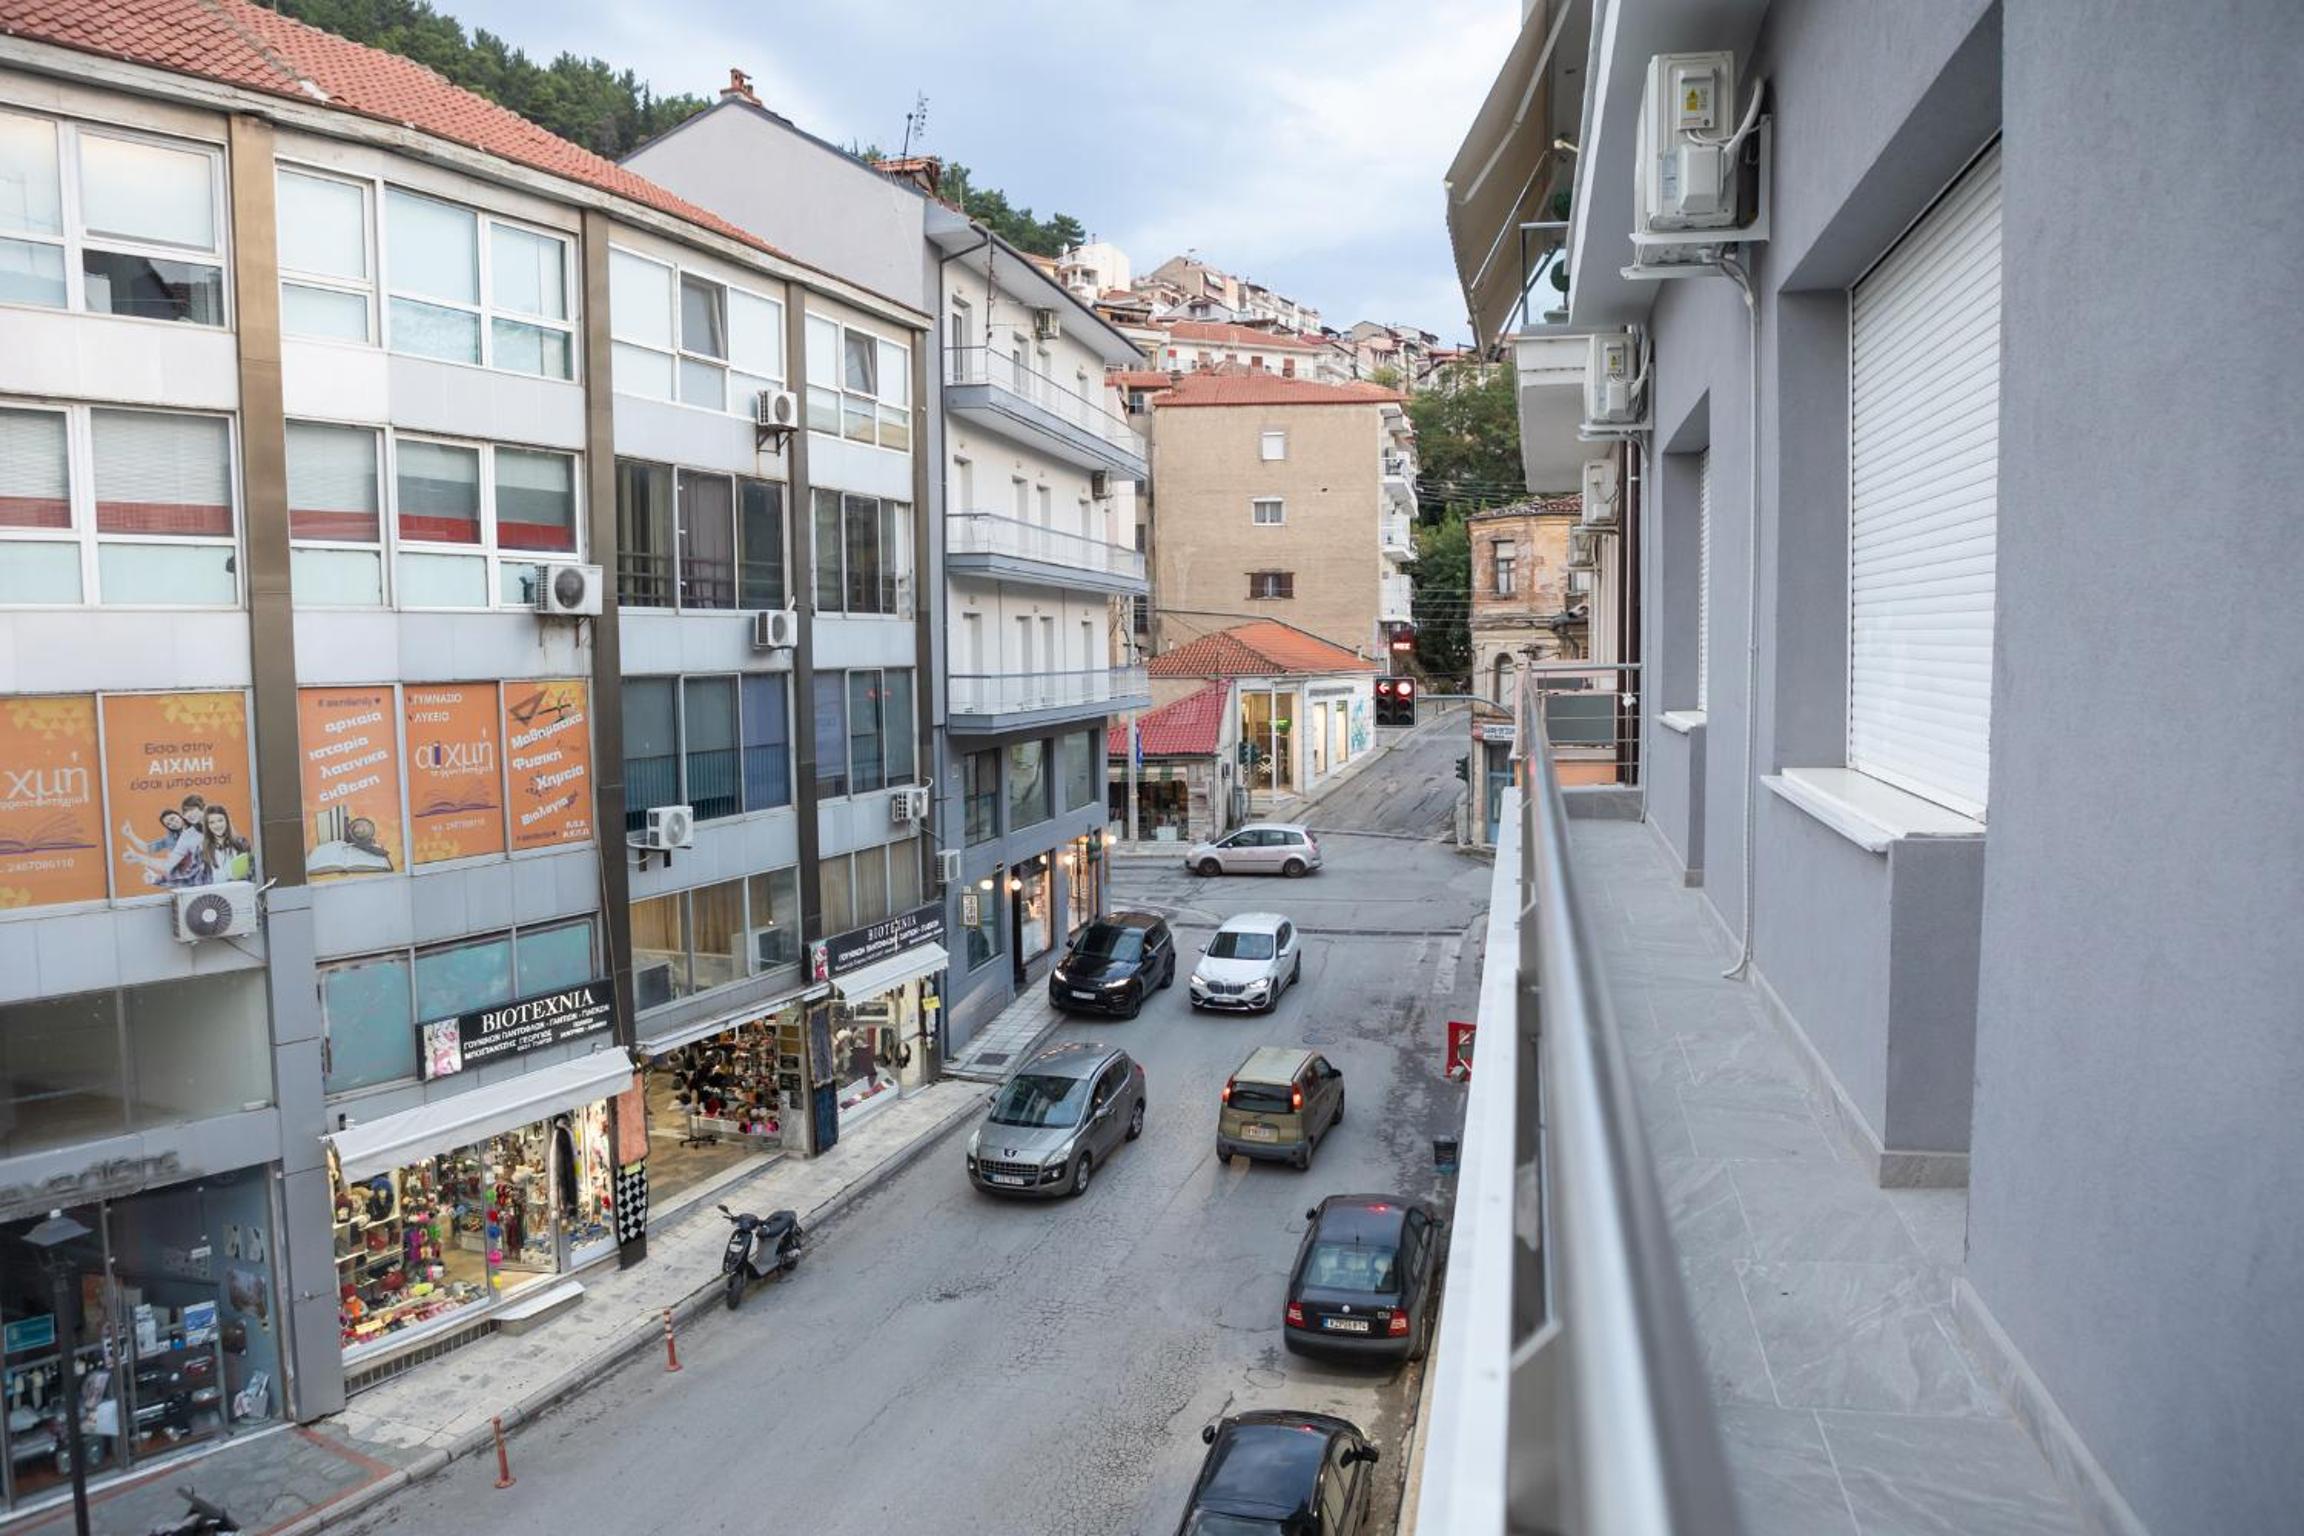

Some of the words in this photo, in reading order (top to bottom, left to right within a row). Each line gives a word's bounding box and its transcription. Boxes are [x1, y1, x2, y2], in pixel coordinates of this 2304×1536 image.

[413, 693, 463, 706] ΓΥΜΝΑΣΙΟ
[414, 712, 450, 723] ΛΥΚΕΙΟ
[149, 757, 214, 775] ΑΙΧΜΗ
